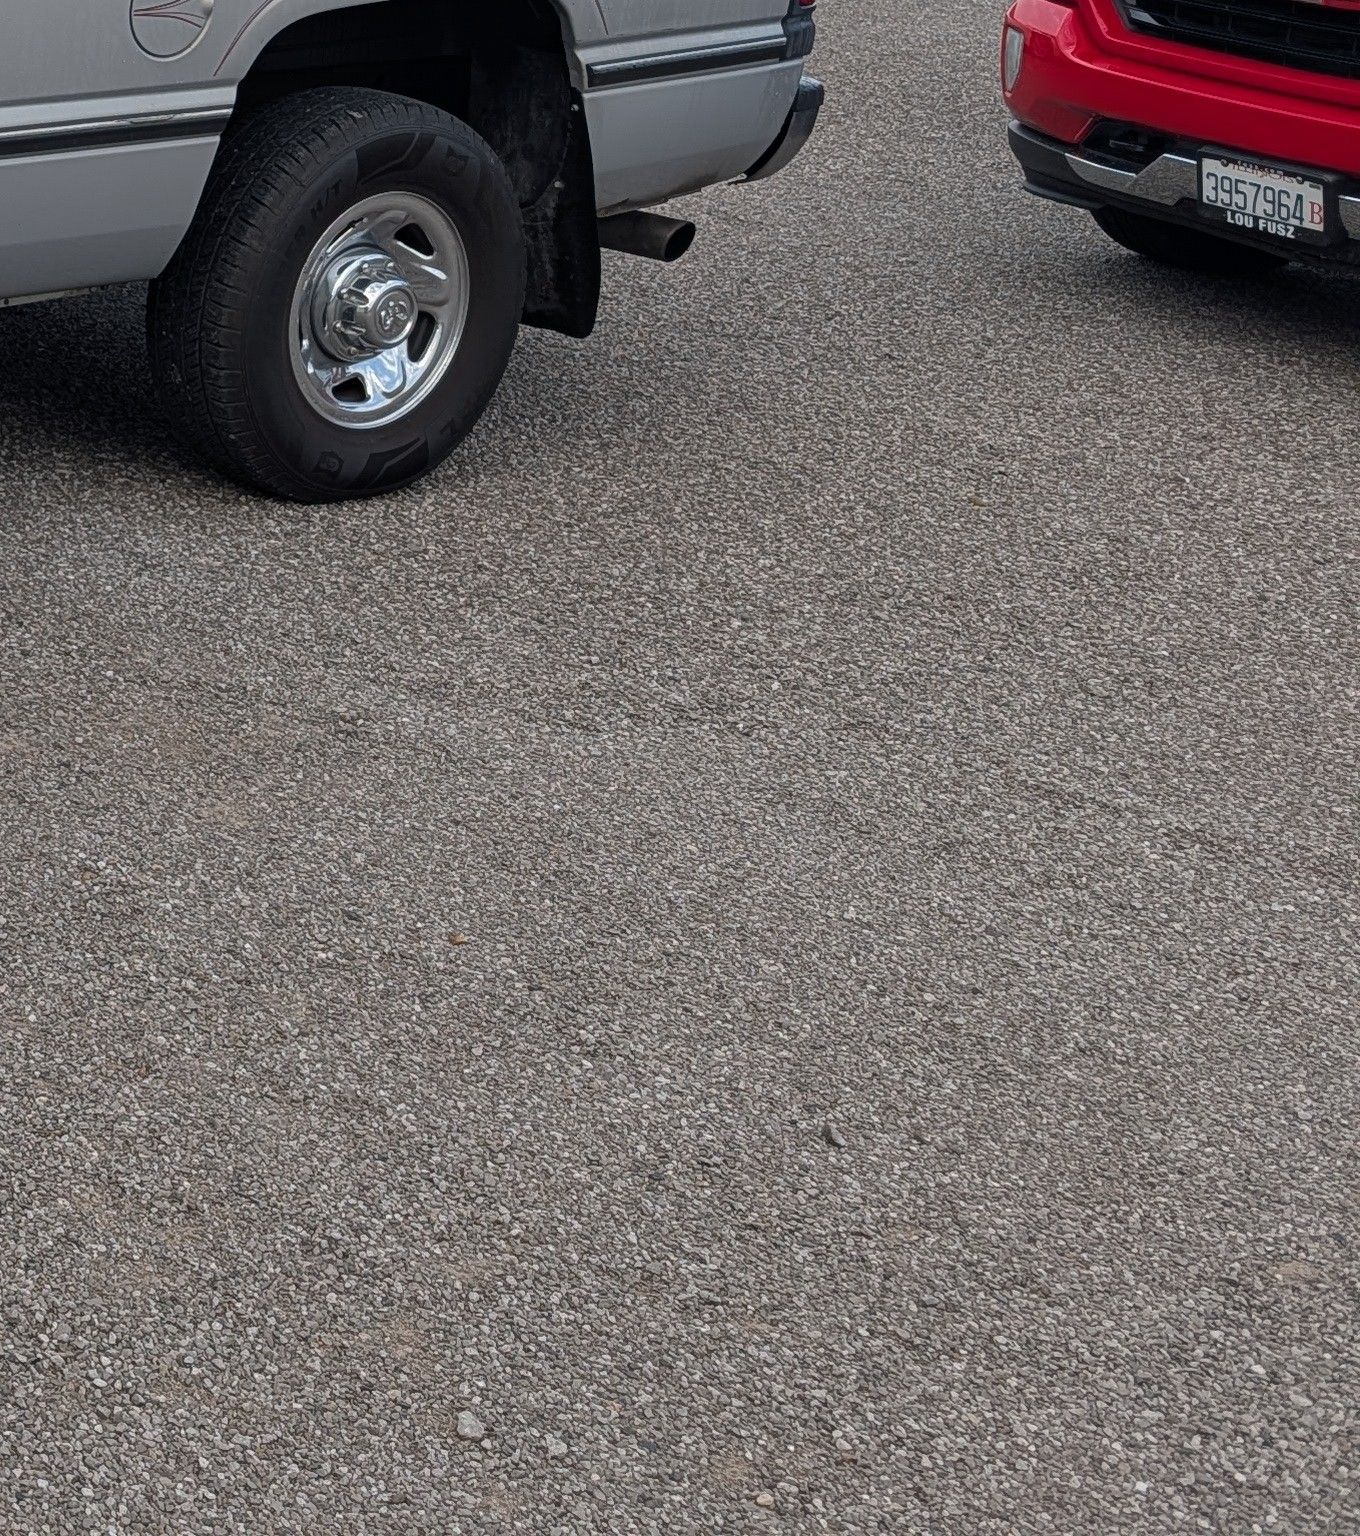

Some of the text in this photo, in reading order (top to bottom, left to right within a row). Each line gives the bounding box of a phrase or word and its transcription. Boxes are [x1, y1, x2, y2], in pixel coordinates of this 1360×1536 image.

[1206, 171, 1304, 226] 3957964
[1308, 201, 1323, 225] B
[1226, 210, 1295, 239] LOU FUSZ
